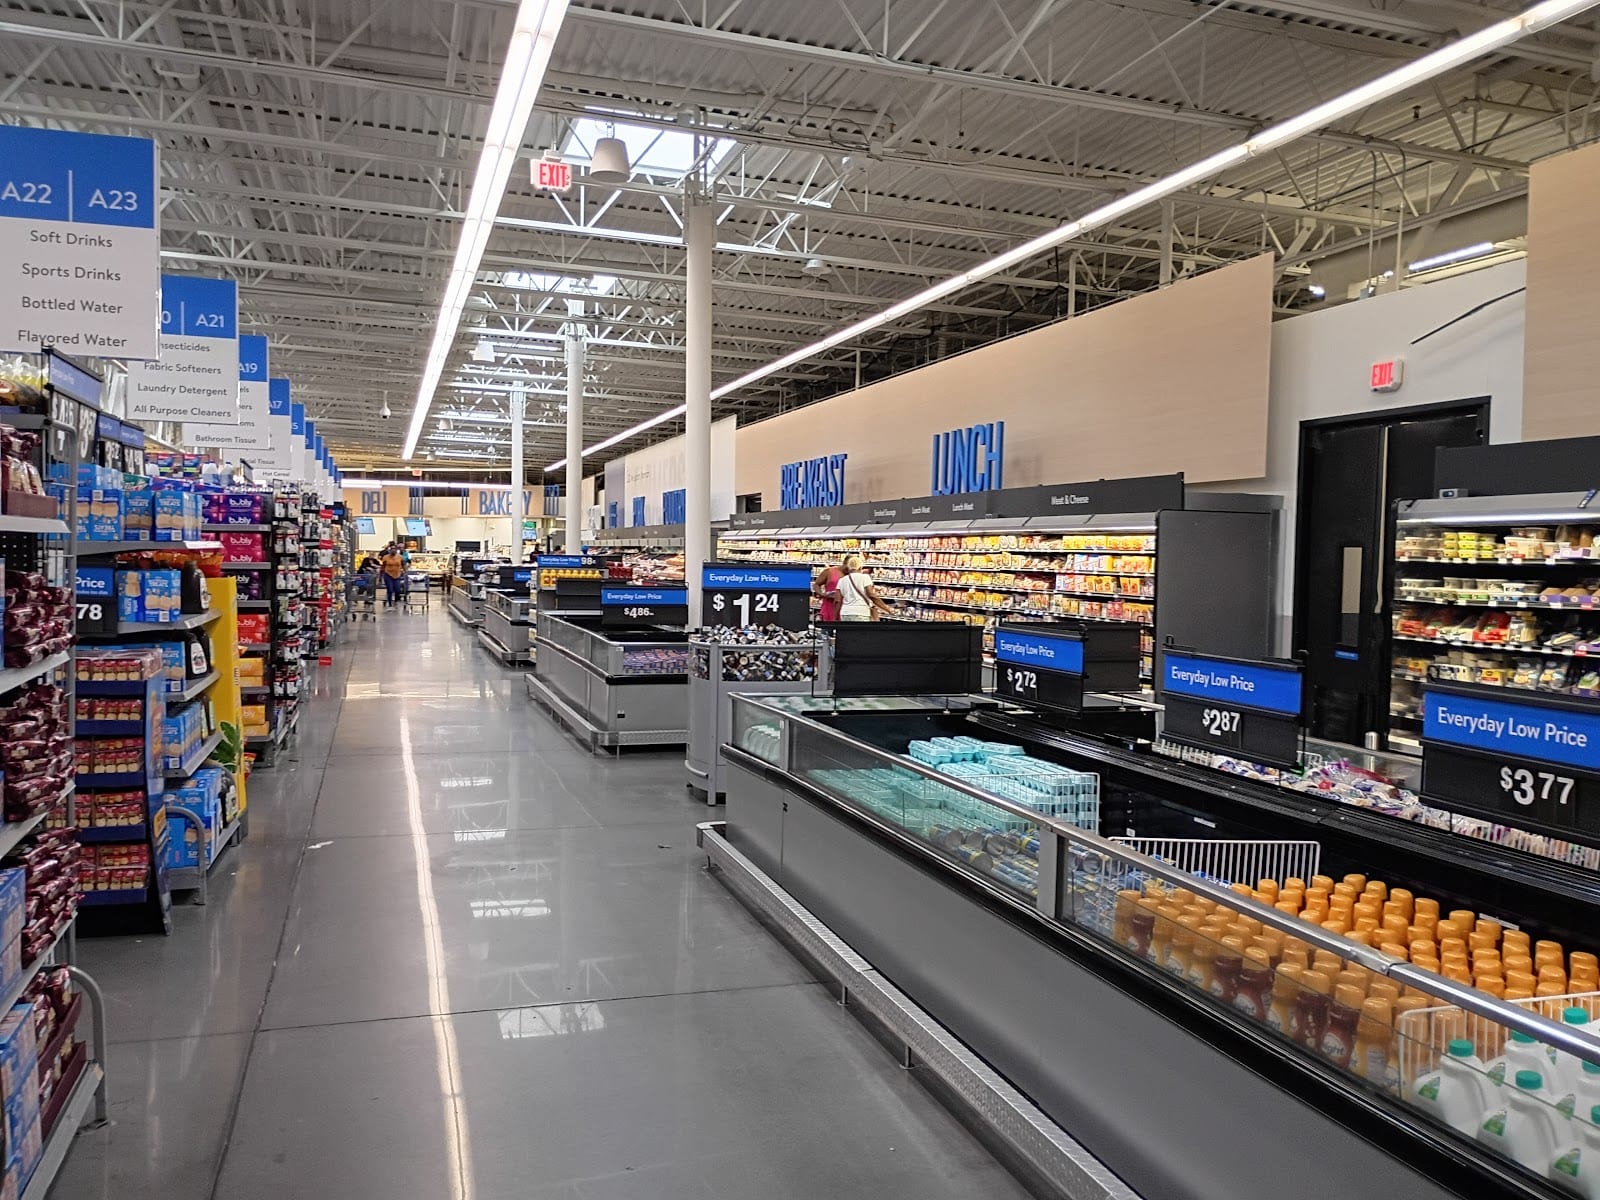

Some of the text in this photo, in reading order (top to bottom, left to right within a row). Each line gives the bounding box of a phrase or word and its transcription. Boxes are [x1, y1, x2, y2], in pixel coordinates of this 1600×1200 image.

[540, 164, 567, 187] EXIT
[1, 181, 52, 204] A22
[88, 189, 138, 211] A23
[30, 230, 113, 248] Soft Drinks
[22, 263, 121, 281] Sports Drinks
[22, 296, 123, 313] Bottled Water
[195, 314, 225, 328] A21
[18, 330, 128, 347] Flavored Water
[144, 361, 222, 375] Fabric Softeners
[1372, 362, 1393, 387] EXIT
[137, 383, 176, 394] Laundry
[179, 385, 228, 396] Detergent
[134, 405, 147, 413] All
[150, 406, 188, 417] Purpose
[191, 407, 232, 418] Cleaners
[195, 434, 257, 445] Bathroom Tissue
[932, 421, 1005, 497] LUNCH
[781, 454, 847, 510] BREAKFAST
[229, 498, 253, 507] bubly
[362, 491, 388, 514] DELI
[479, 490, 532, 516] BAKEY
[1051, 495, 1064, 505] Meat
[228, 516, 252, 525] bubly
[230, 537, 253, 545] bubly
[75, 577, 106, 588] Price
[709, 573, 743, 583] Everyday
[745, 574, 759, 582] Low
[1000, 640, 1055, 658] Everyday Low Price
[1171, 666, 1255, 692] Everyday Low Price
[1438, 706, 1588, 747] Everyday Low Price
